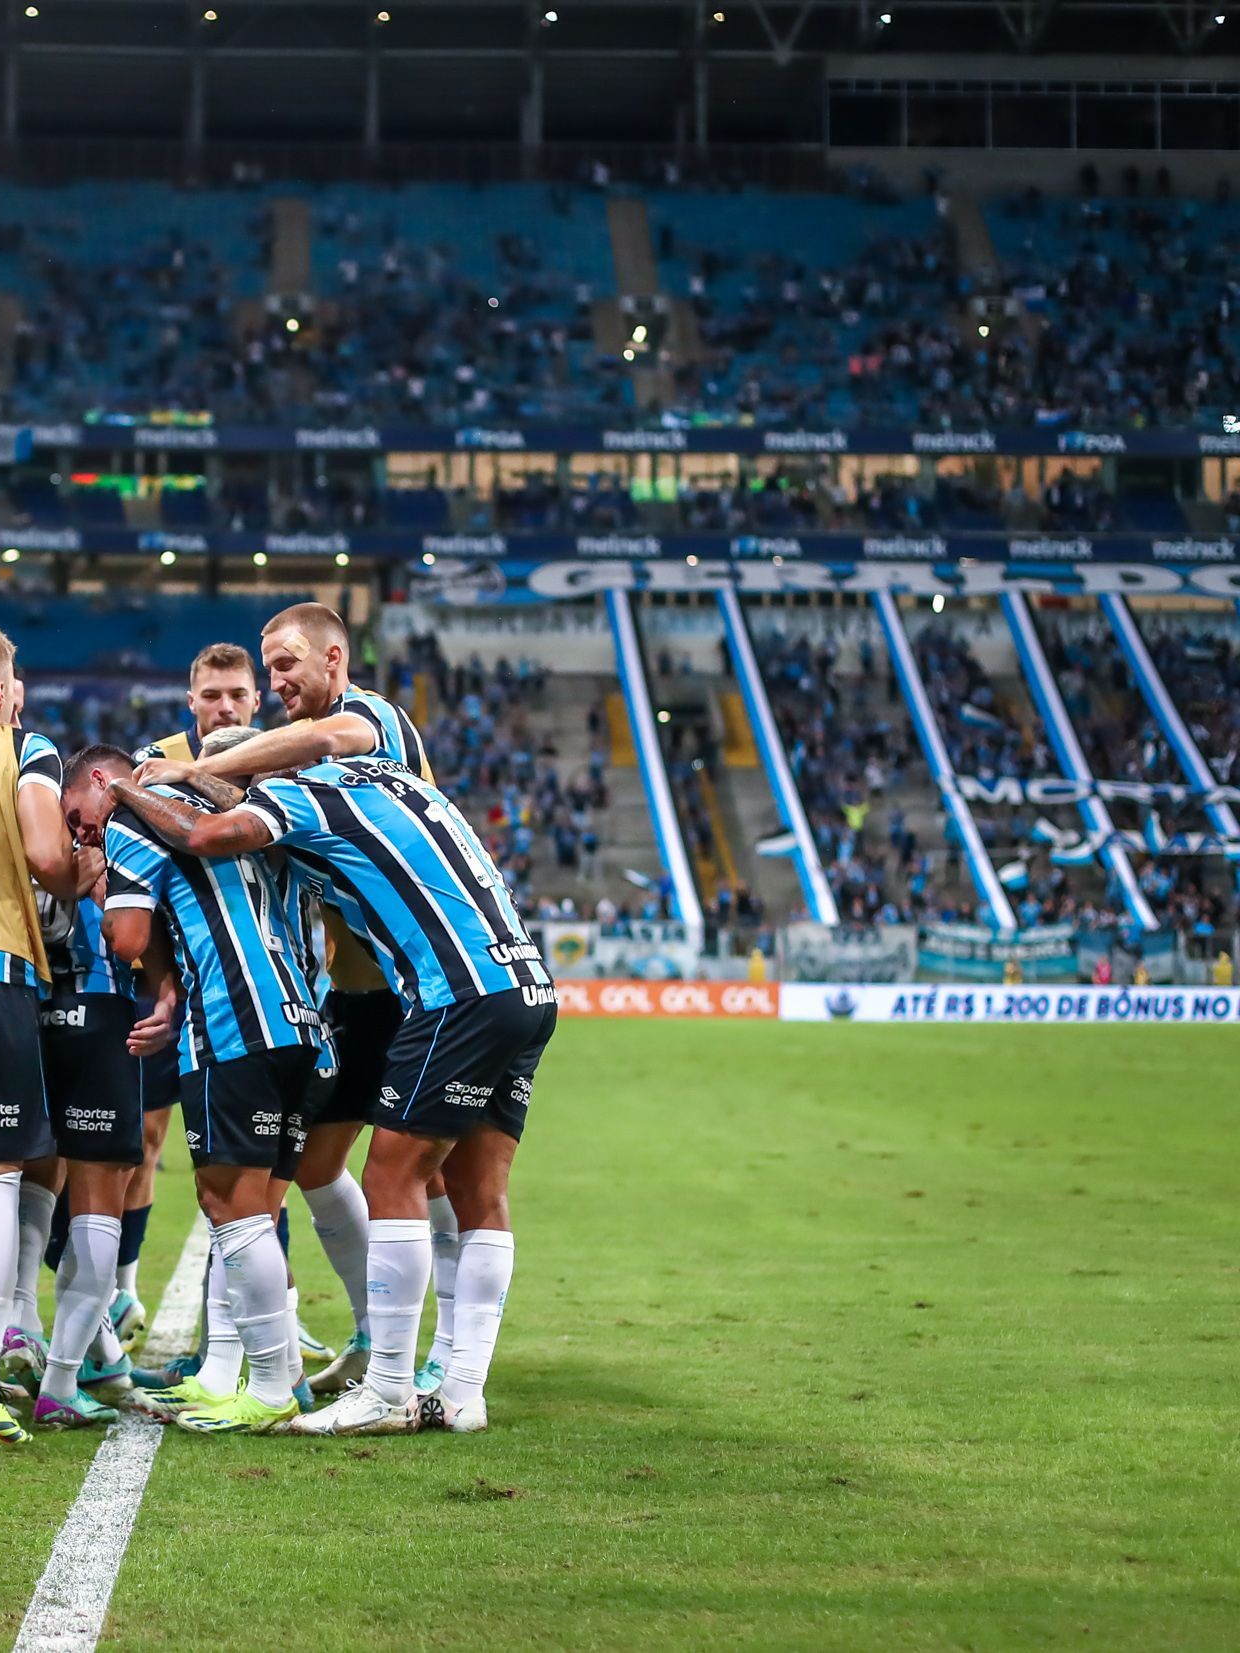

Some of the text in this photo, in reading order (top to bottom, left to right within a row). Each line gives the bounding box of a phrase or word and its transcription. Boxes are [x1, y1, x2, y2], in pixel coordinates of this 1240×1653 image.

[893, 987, 937, 1016] ATÉ
[1057, 995, 1089, 1017] DE
[1096, 987, 1185, 1018] BÔNUS
[1192, 995, 1232, 1017] NO
[65, 1105, 117, 1120] Esportes
